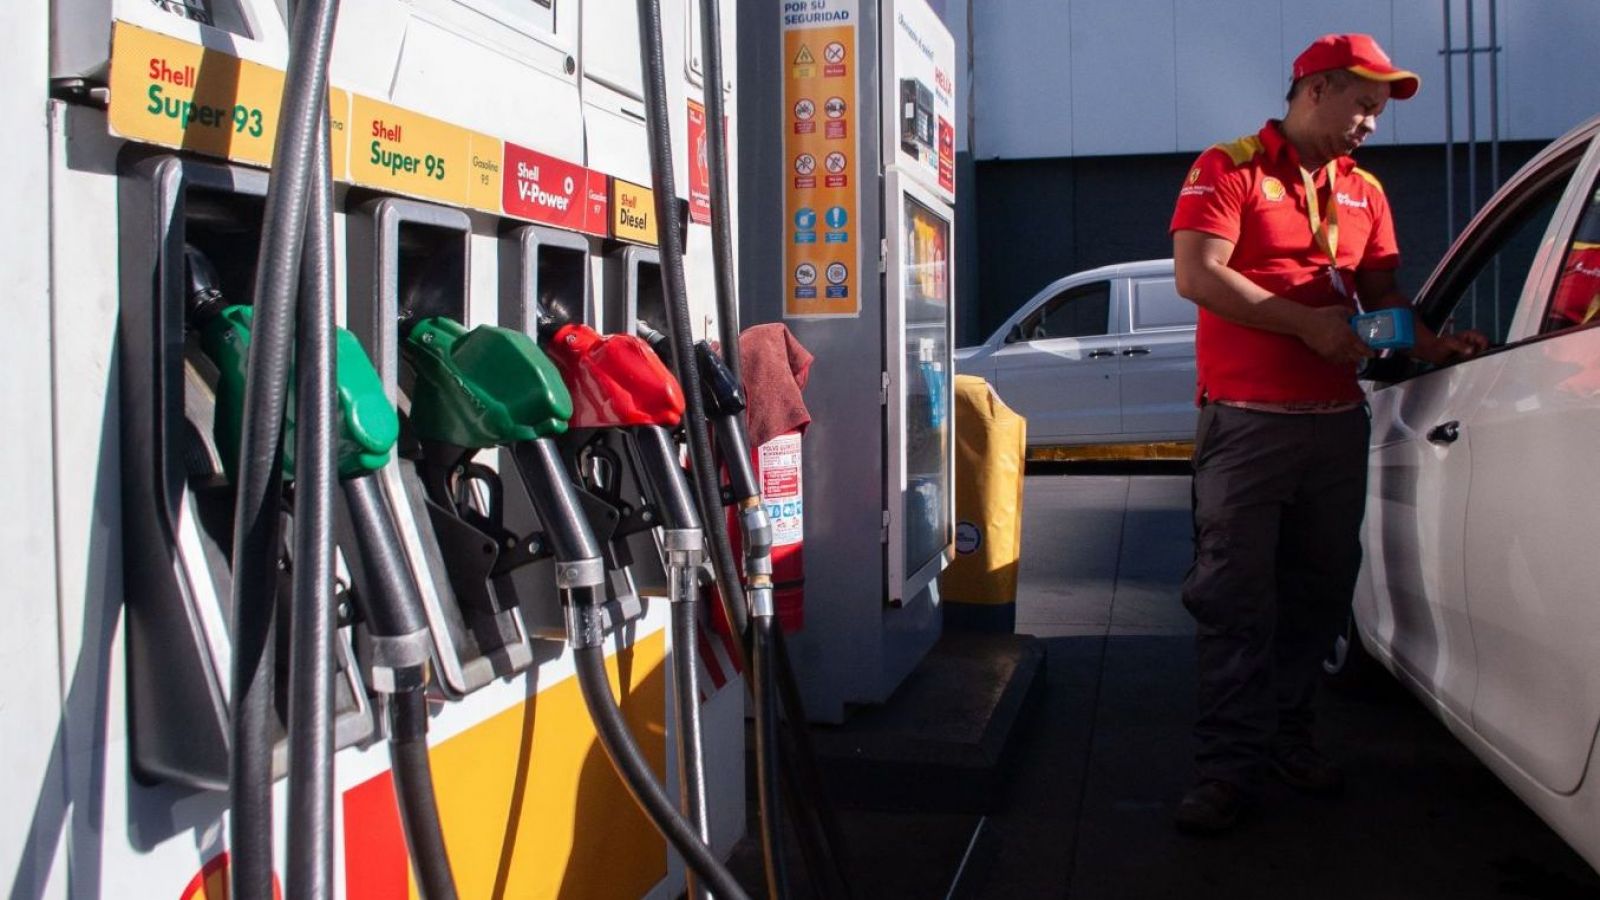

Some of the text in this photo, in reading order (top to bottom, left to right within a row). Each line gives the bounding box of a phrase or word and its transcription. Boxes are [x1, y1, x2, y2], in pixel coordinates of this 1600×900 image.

[784, 0, 826, 13] POR SU
[784, 10, 850, 25] SEGURIDAD
[149, 58, 195, 88] Shell
[147, 84, 263, 138] Super 93
[372, 120, 402, 143] Shell
[370, 140, 446, 181] Super 95
[472, 155, 499, 173] Gasolina
[517, 161, 540, 181] Shell
[481, 174, 490, 186] 95
[517, 179, 569, 211] V-Power
[620, 193, 637, 209] Shell
[620, 208, 648, 231] Diesel
